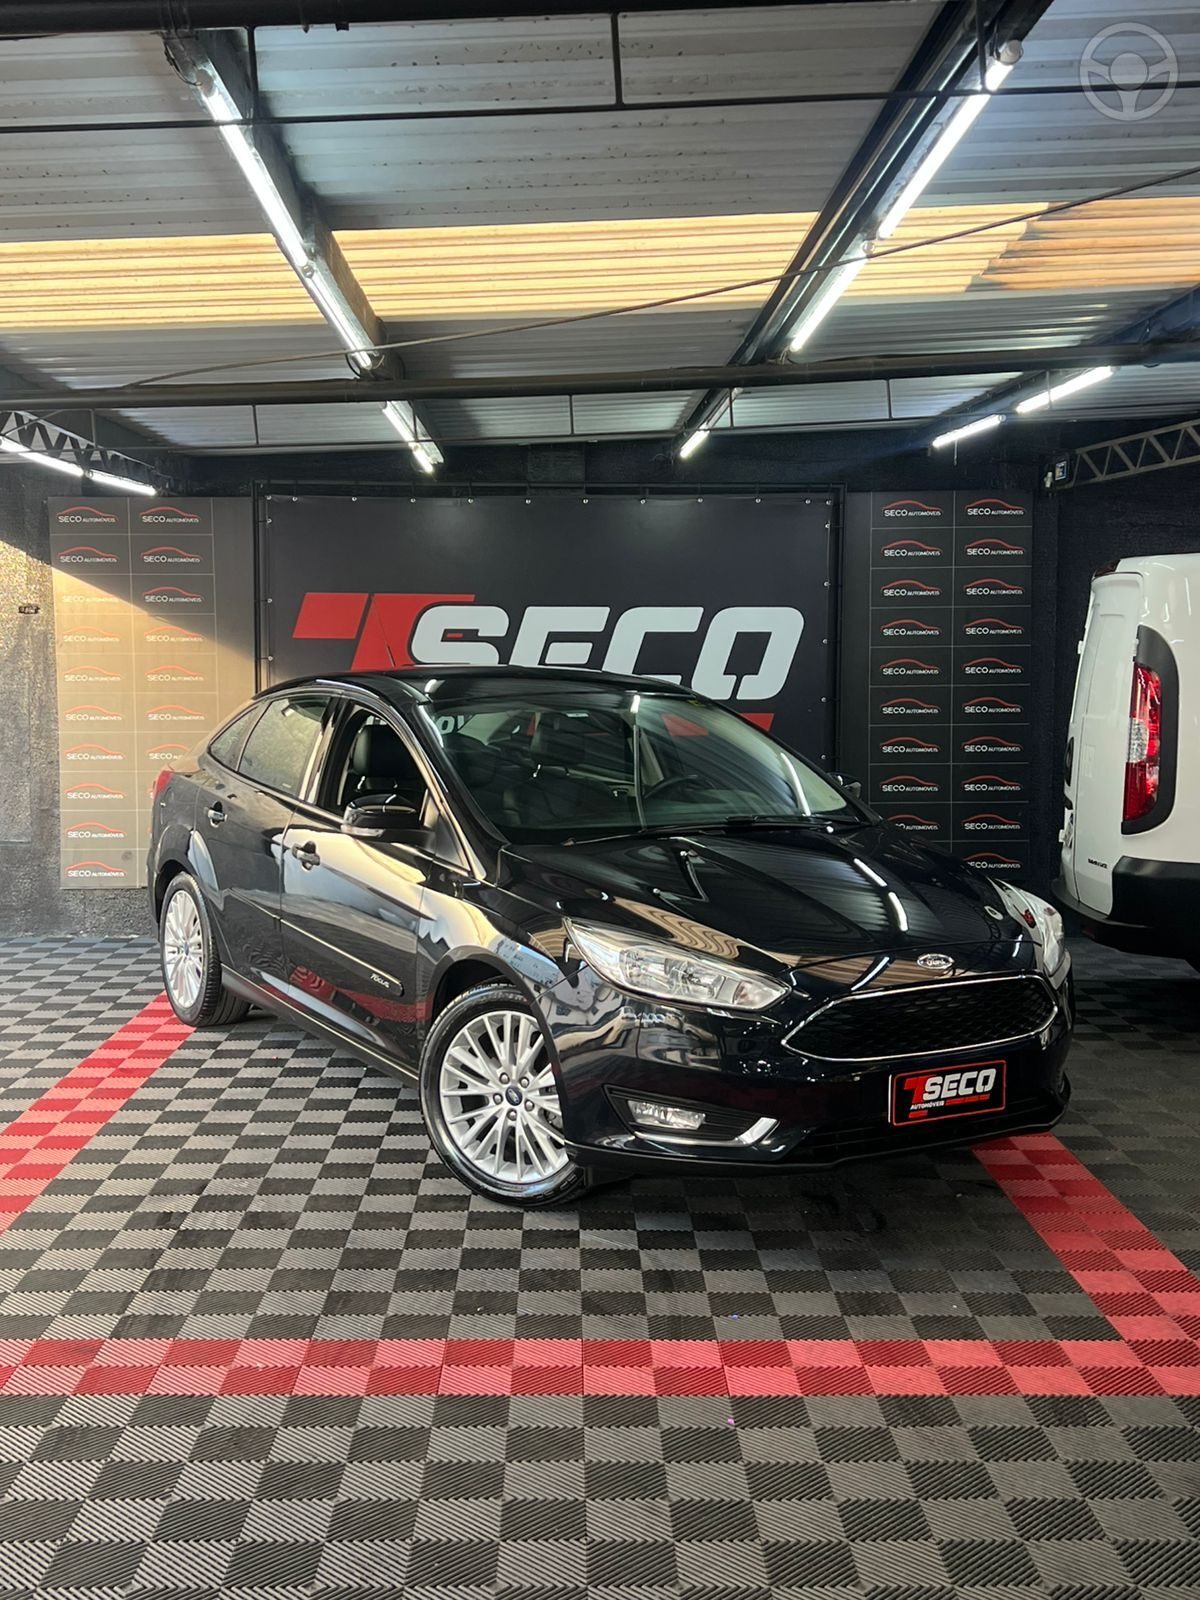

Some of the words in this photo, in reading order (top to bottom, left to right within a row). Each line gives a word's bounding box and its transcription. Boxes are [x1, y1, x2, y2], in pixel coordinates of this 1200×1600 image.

[142, 515, 165, 523] SECO
[885, 509, 907, 517] SECO
[410, 605, 805, 699] SECO
[923, 1068, 996, 1101] SECO
